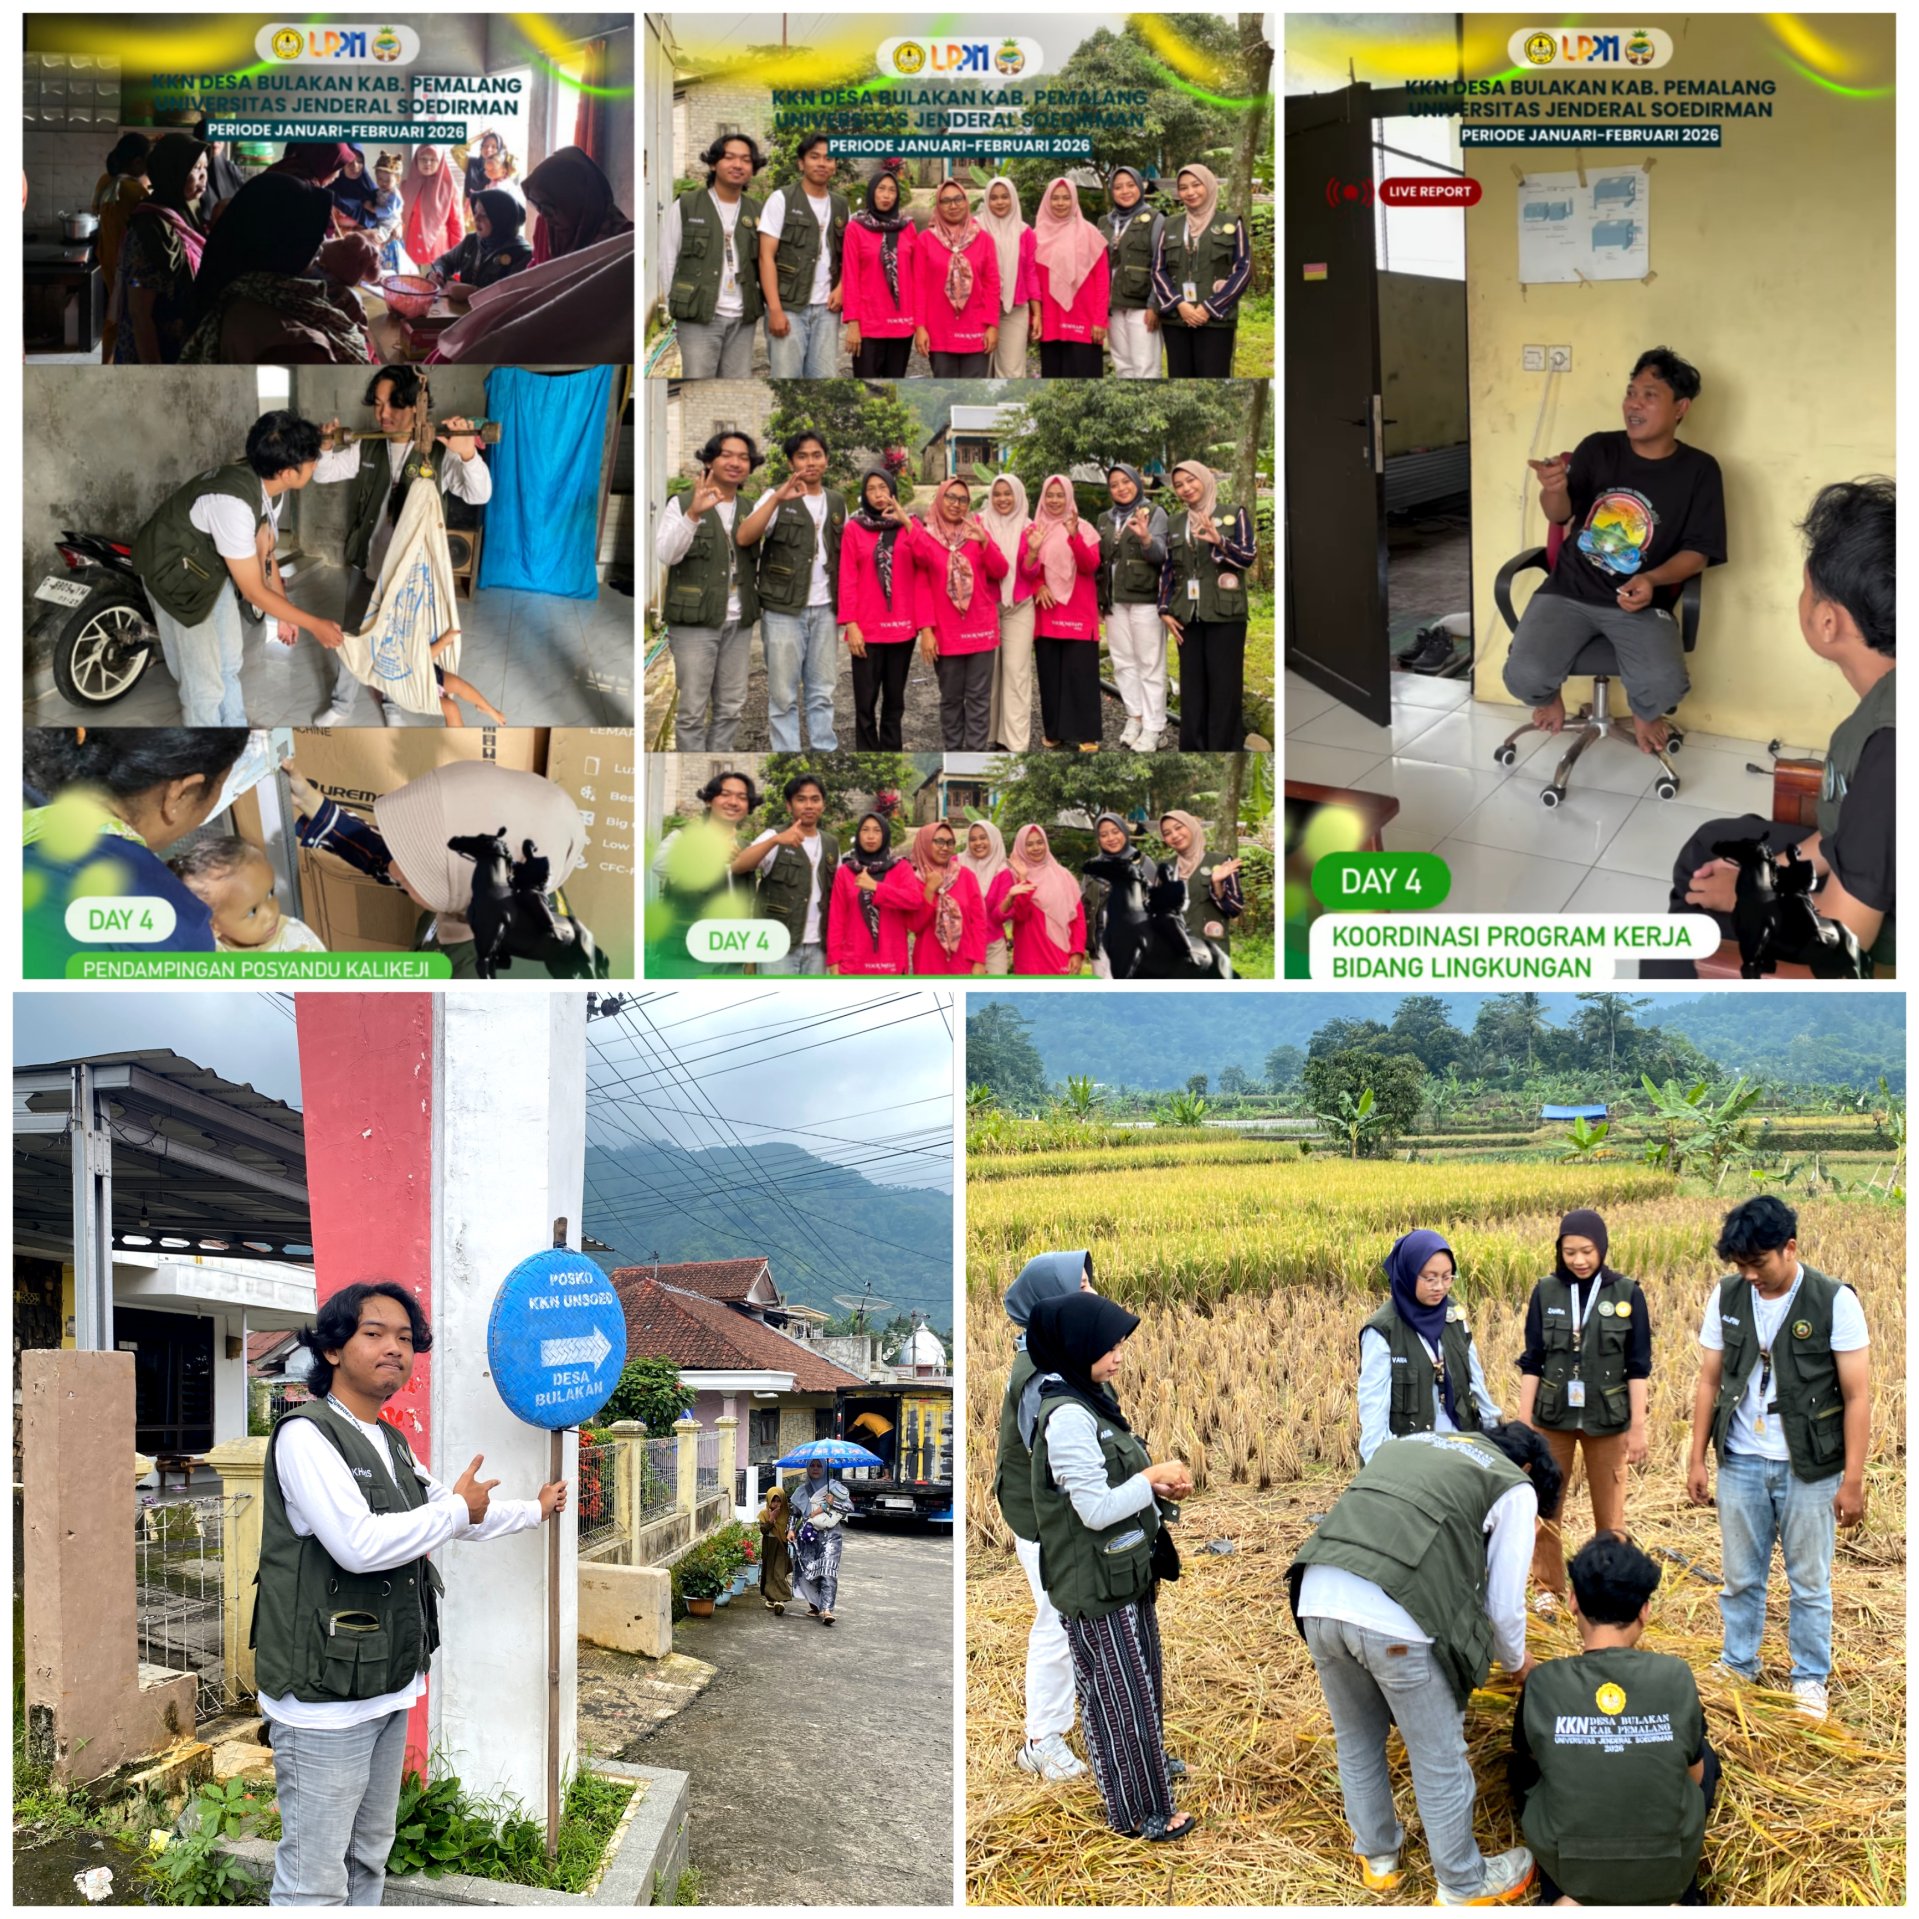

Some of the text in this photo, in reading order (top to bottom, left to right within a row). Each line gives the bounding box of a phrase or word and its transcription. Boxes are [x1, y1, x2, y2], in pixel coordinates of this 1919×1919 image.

[606, 816, 628, 830] Big
[602, 839, 630, 851] Low
[550, 1272, 593, 1286] POSKO
[529, 1292, 613, 1310] KKN UNSOED
[553, 1371, 590, 1386] DESA
[535, 1381, 603, 1407] BULAKAN
[1555, 1713, 1670, 1734] KKN DESA BULAKAN
[1618, 1723, 1671, 1735] PEMALANG
